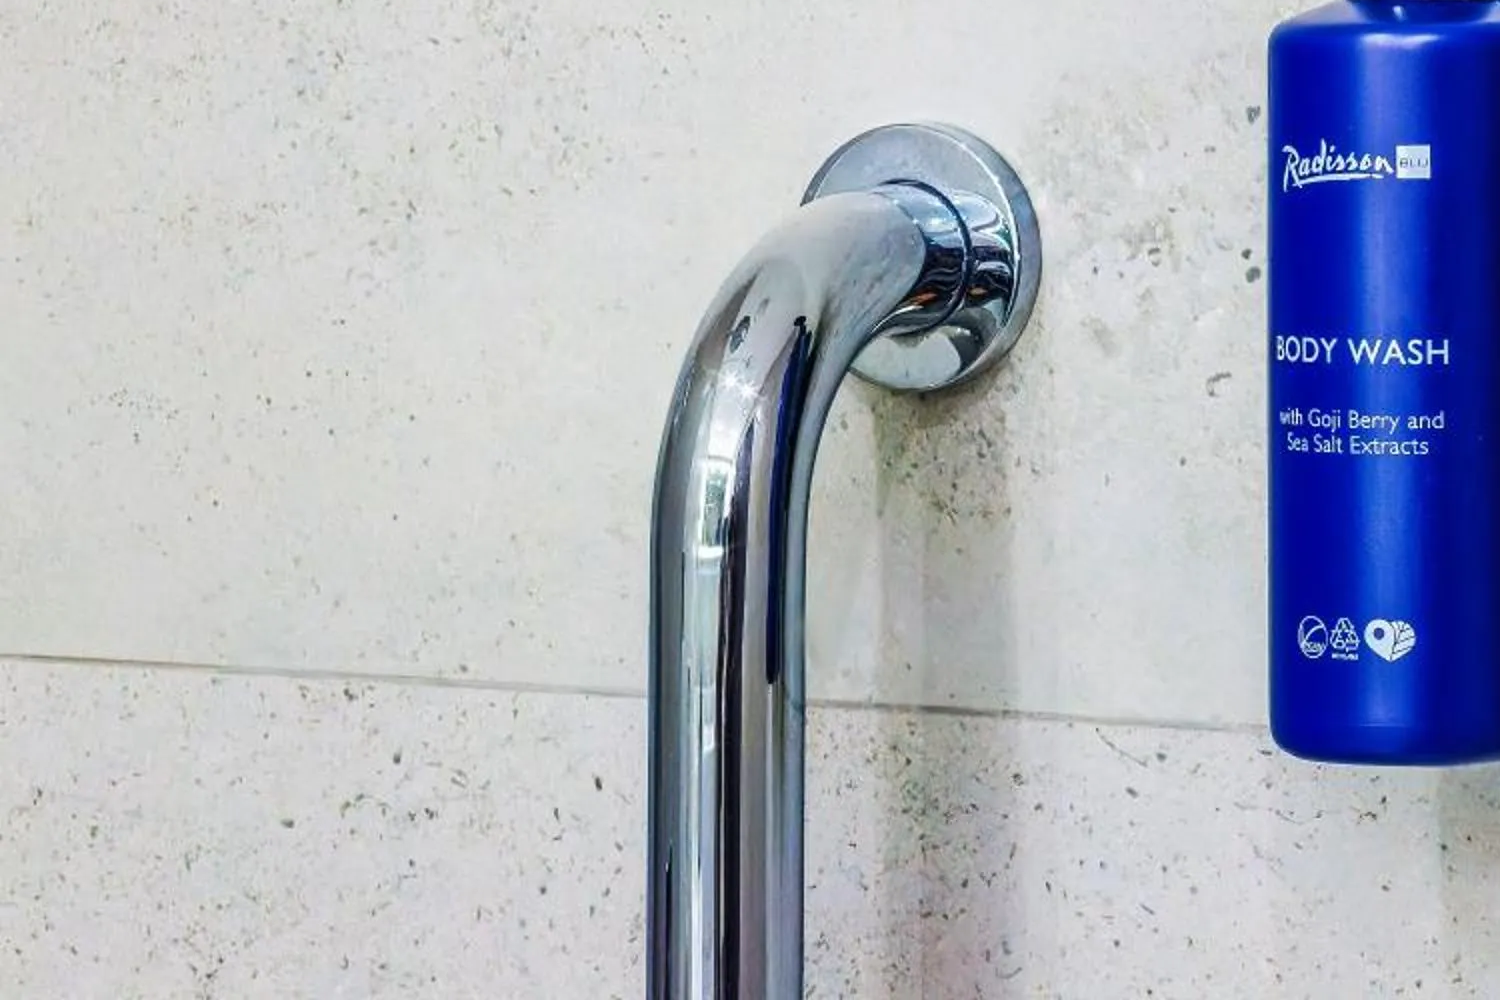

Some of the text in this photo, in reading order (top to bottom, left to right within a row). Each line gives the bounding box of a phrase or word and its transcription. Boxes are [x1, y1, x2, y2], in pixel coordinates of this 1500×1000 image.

[1282, 138, 1394, 192] Radisson
[1276, 335, 1450, 366] BODY WASH
[1279, 407, 1446, 435] with Goji Berry and
[1287, 431, 1430, 455] Sea Salt Extracts
